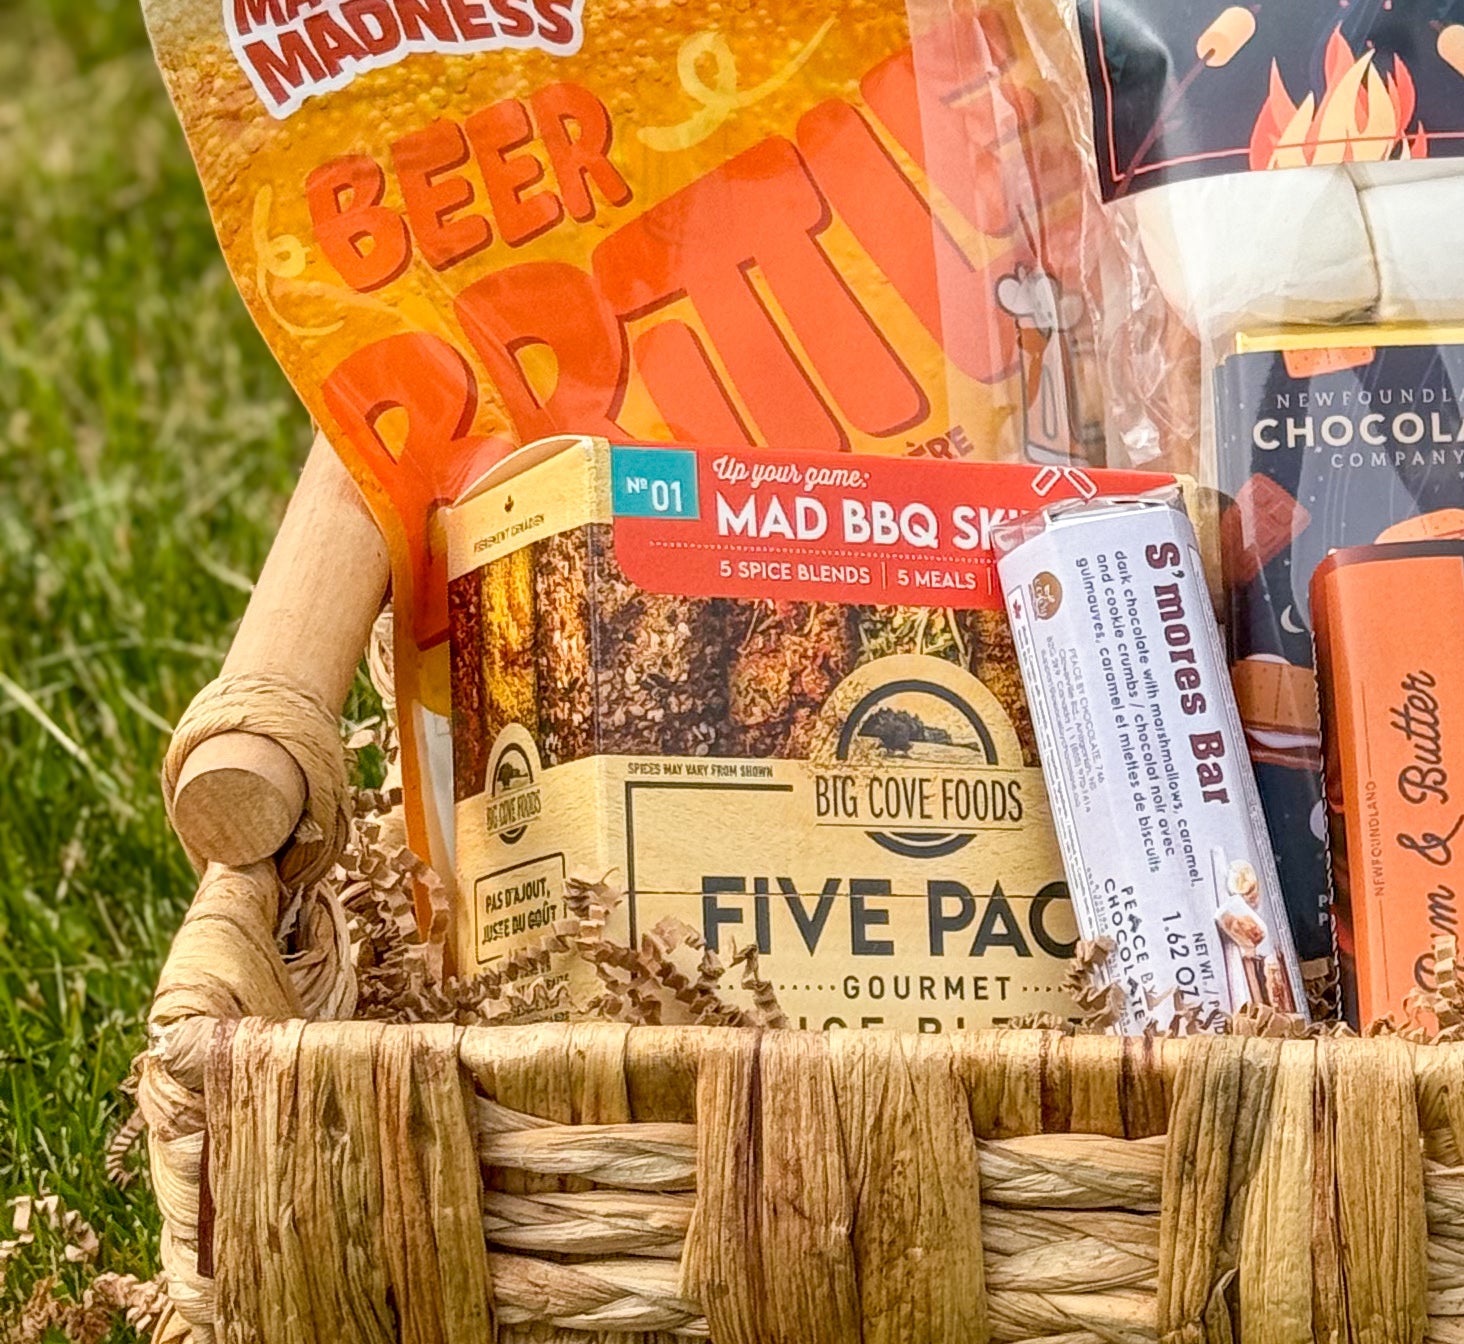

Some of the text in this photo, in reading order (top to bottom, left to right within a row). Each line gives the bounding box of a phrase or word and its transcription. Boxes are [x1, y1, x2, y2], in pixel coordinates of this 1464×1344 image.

[306, 83, 632, 293] BEER
[713, 455, 871, 493] Up your game:
[1331, 449, 1464, 469] COMPANY
[651, 479, 682, 513] 01
[716, 492, 828, 541] MAD
[841, 499, 938, 549] BBQ
[719, 560, 977, 590] 5 SPICE BLENDS 5 MEALS
[1096, 554, 1112, 584] and
[1104, 587, 1124, 639] cookie
[1114, 550, 1131, 584] dark
[1124, 589, 1150, 664] chocolate
[1143, 668, 1157, 699] with
[1151, 703, 1184, 814] marshmallows,
[1117, 642, 1139, 698] crumbs
[1145, 542, 1230, 805] S'mores Bar
[1076, 557, 1160, 873] guimauves, caramel et miettes de biscuits
[1390, 670, 1448, 805] Butter
[627, 761, 774, 778] SPICES MAY VARY FROM SHOWN
[1134, 713, 1160, 781] chocolat
[816, 775, 1024, 823] BIG COVE FOODS
[1149, 780, 1168, 813] noir
[1158, 819, 1176, 857] avec
[1365, 780, 1386, 898] NEWFOUNDLAND
[485, 877, 550, 914] PAS D'AJOUT,
[701, 875, 895, 958] FIVE
[927, 879, 1083, 959] PAC
[482, 918, 510, 945] JUSTE
[512, 914, 526, 933] DU
[1103, 877, 1147, 1021] CHOCOLATE
[1120, 885, 1150, 963] PEACE
[1139, 972, 1156, 997] BY
[1162, 910, 1200, 1000] 1.62 OZ
[1192, 932, 1208, 957] NET
[843, 975, 1011, 1001] GOURMET
